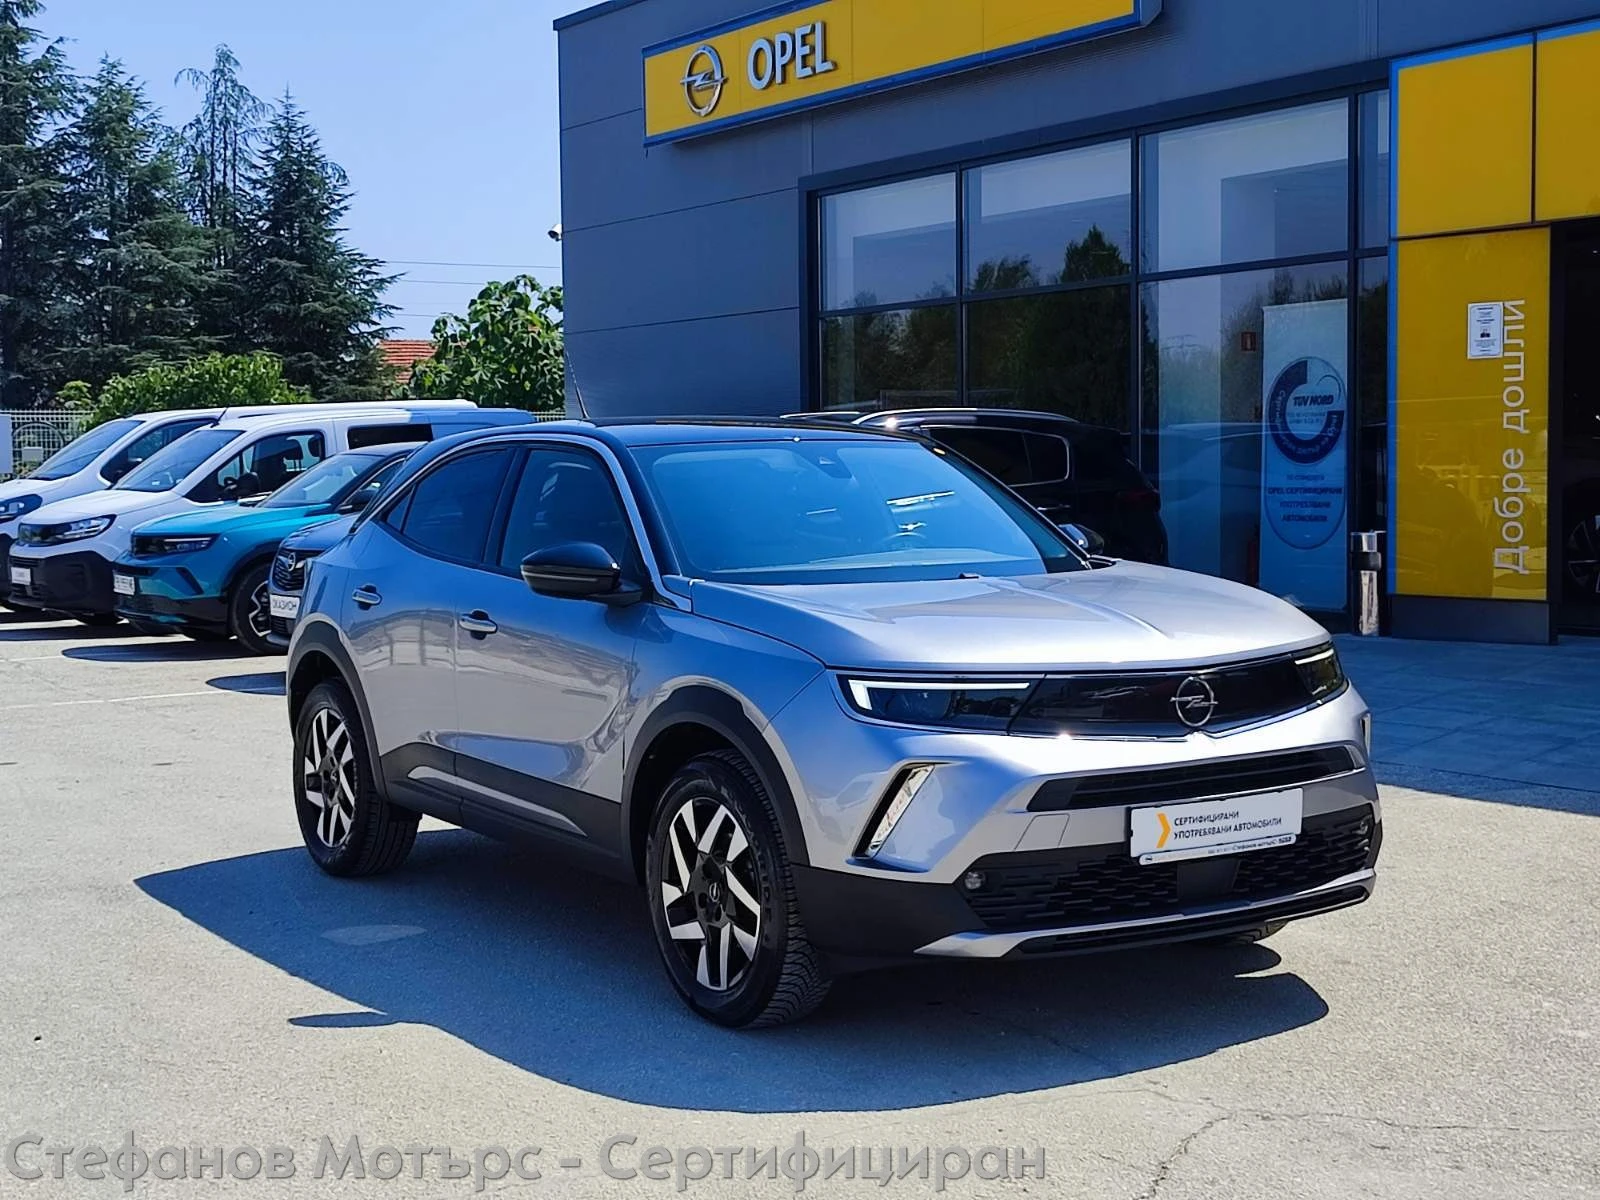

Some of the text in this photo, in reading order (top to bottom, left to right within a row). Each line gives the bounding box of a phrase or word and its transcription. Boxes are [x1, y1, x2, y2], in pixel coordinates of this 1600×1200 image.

[747, 21, 836, 90] OPEL
[1493, 300, 1531, 575] Добре дошли
[1173, 817, 1282, 840] УПОТРЕБЯВАНИ АВТОМОБИЛИ
[1174, 811, 1240, 826] СЕРТИФИЦИРАНИ
